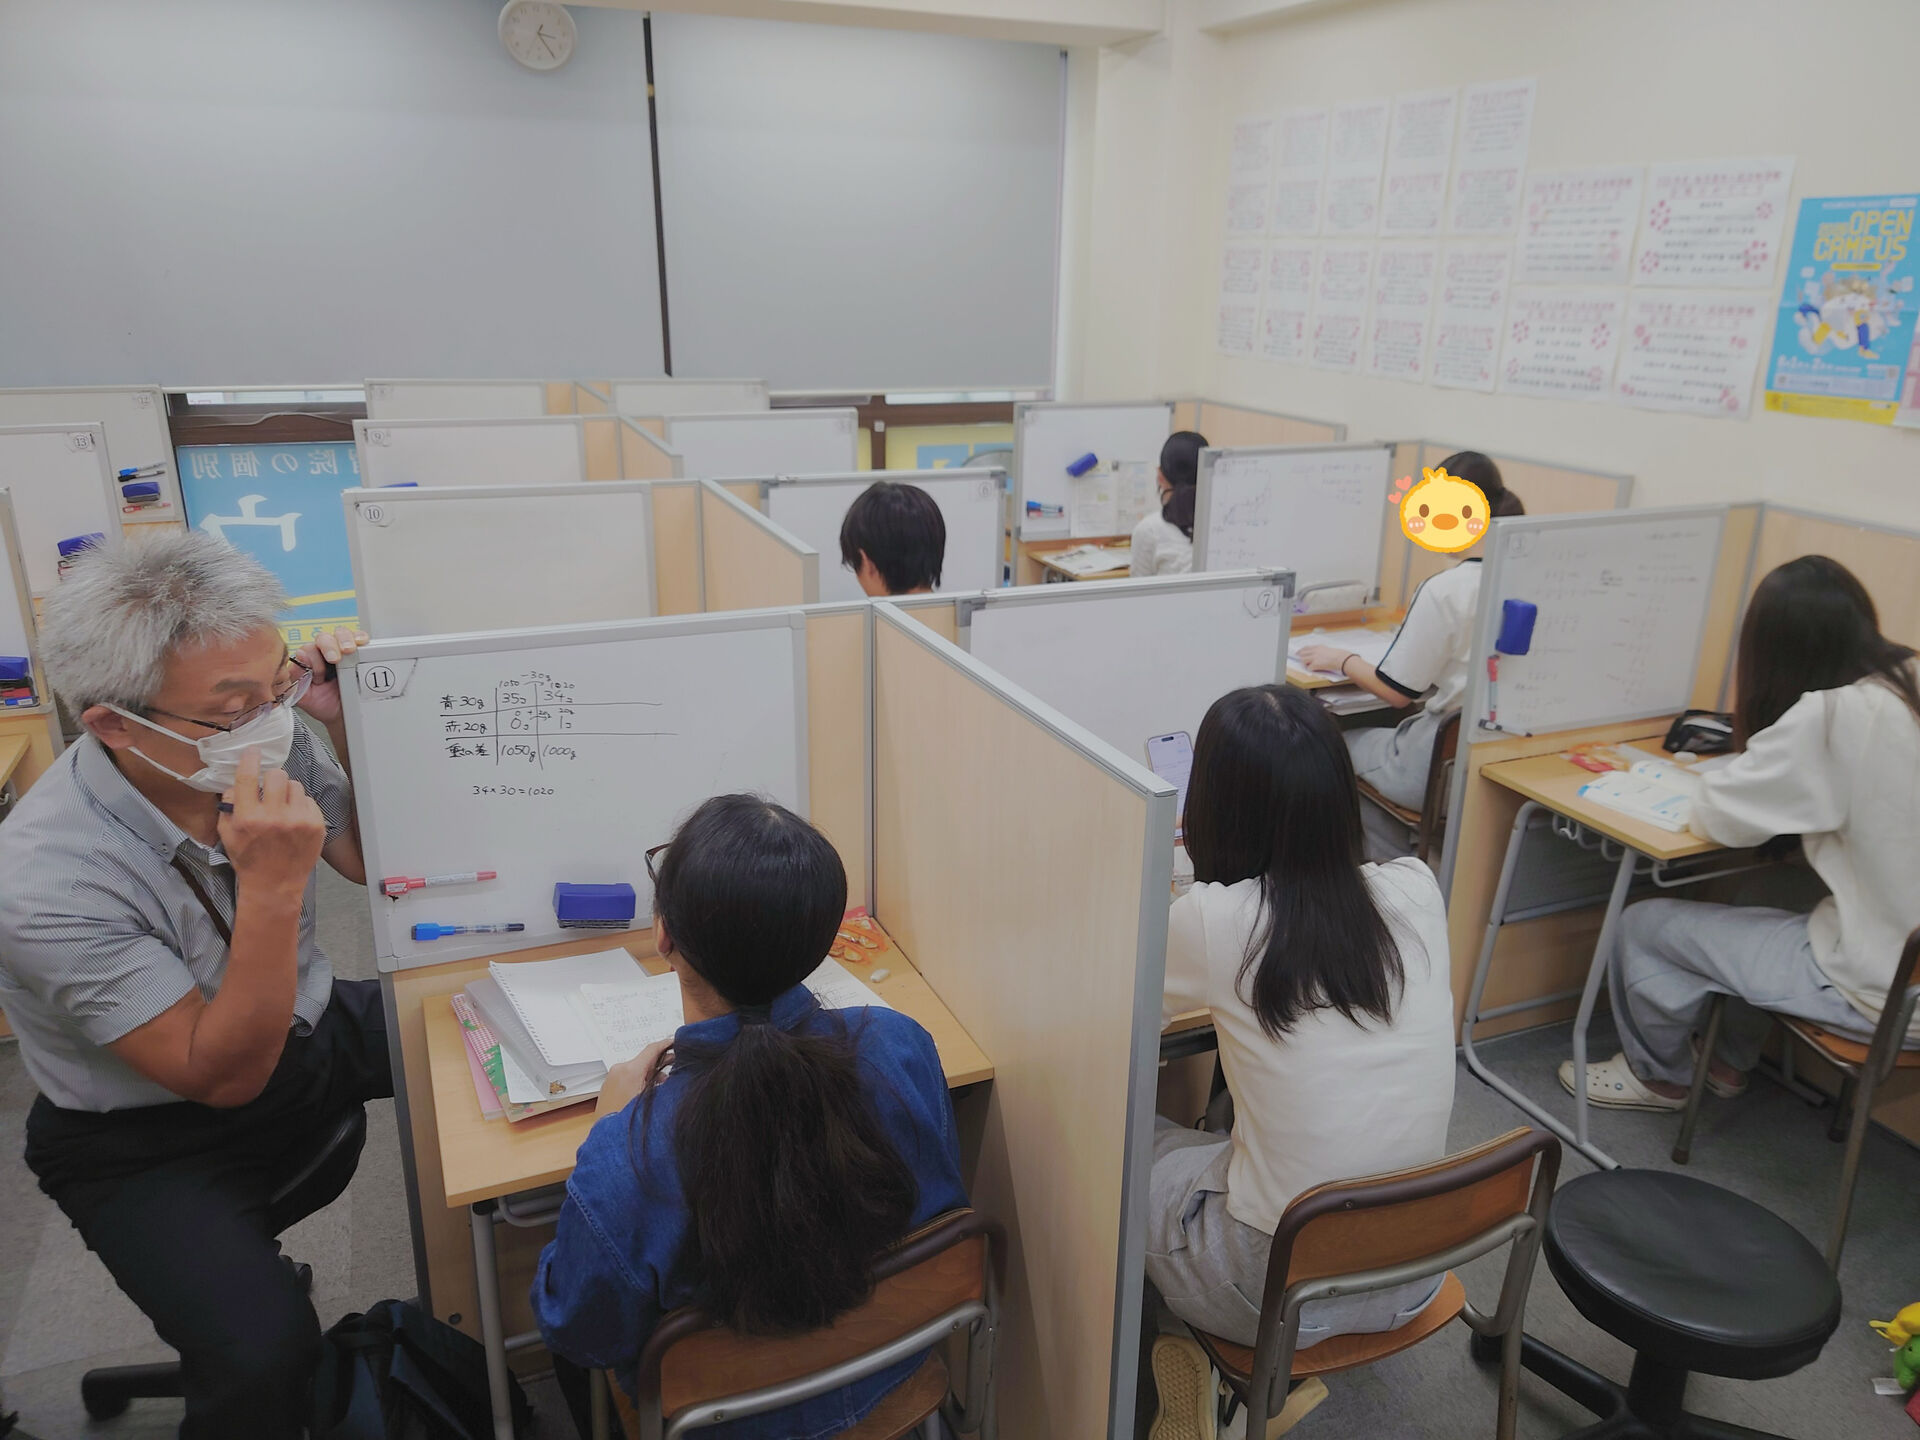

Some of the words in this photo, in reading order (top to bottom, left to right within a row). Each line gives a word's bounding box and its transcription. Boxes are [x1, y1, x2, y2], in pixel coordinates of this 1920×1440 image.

[1850, 210, 1914, 235] OPEN
[1812, 234, 1909, 261] CAMPUS
[367, 507, 381, 520] 10
[369, 670, 391, 689] 11
